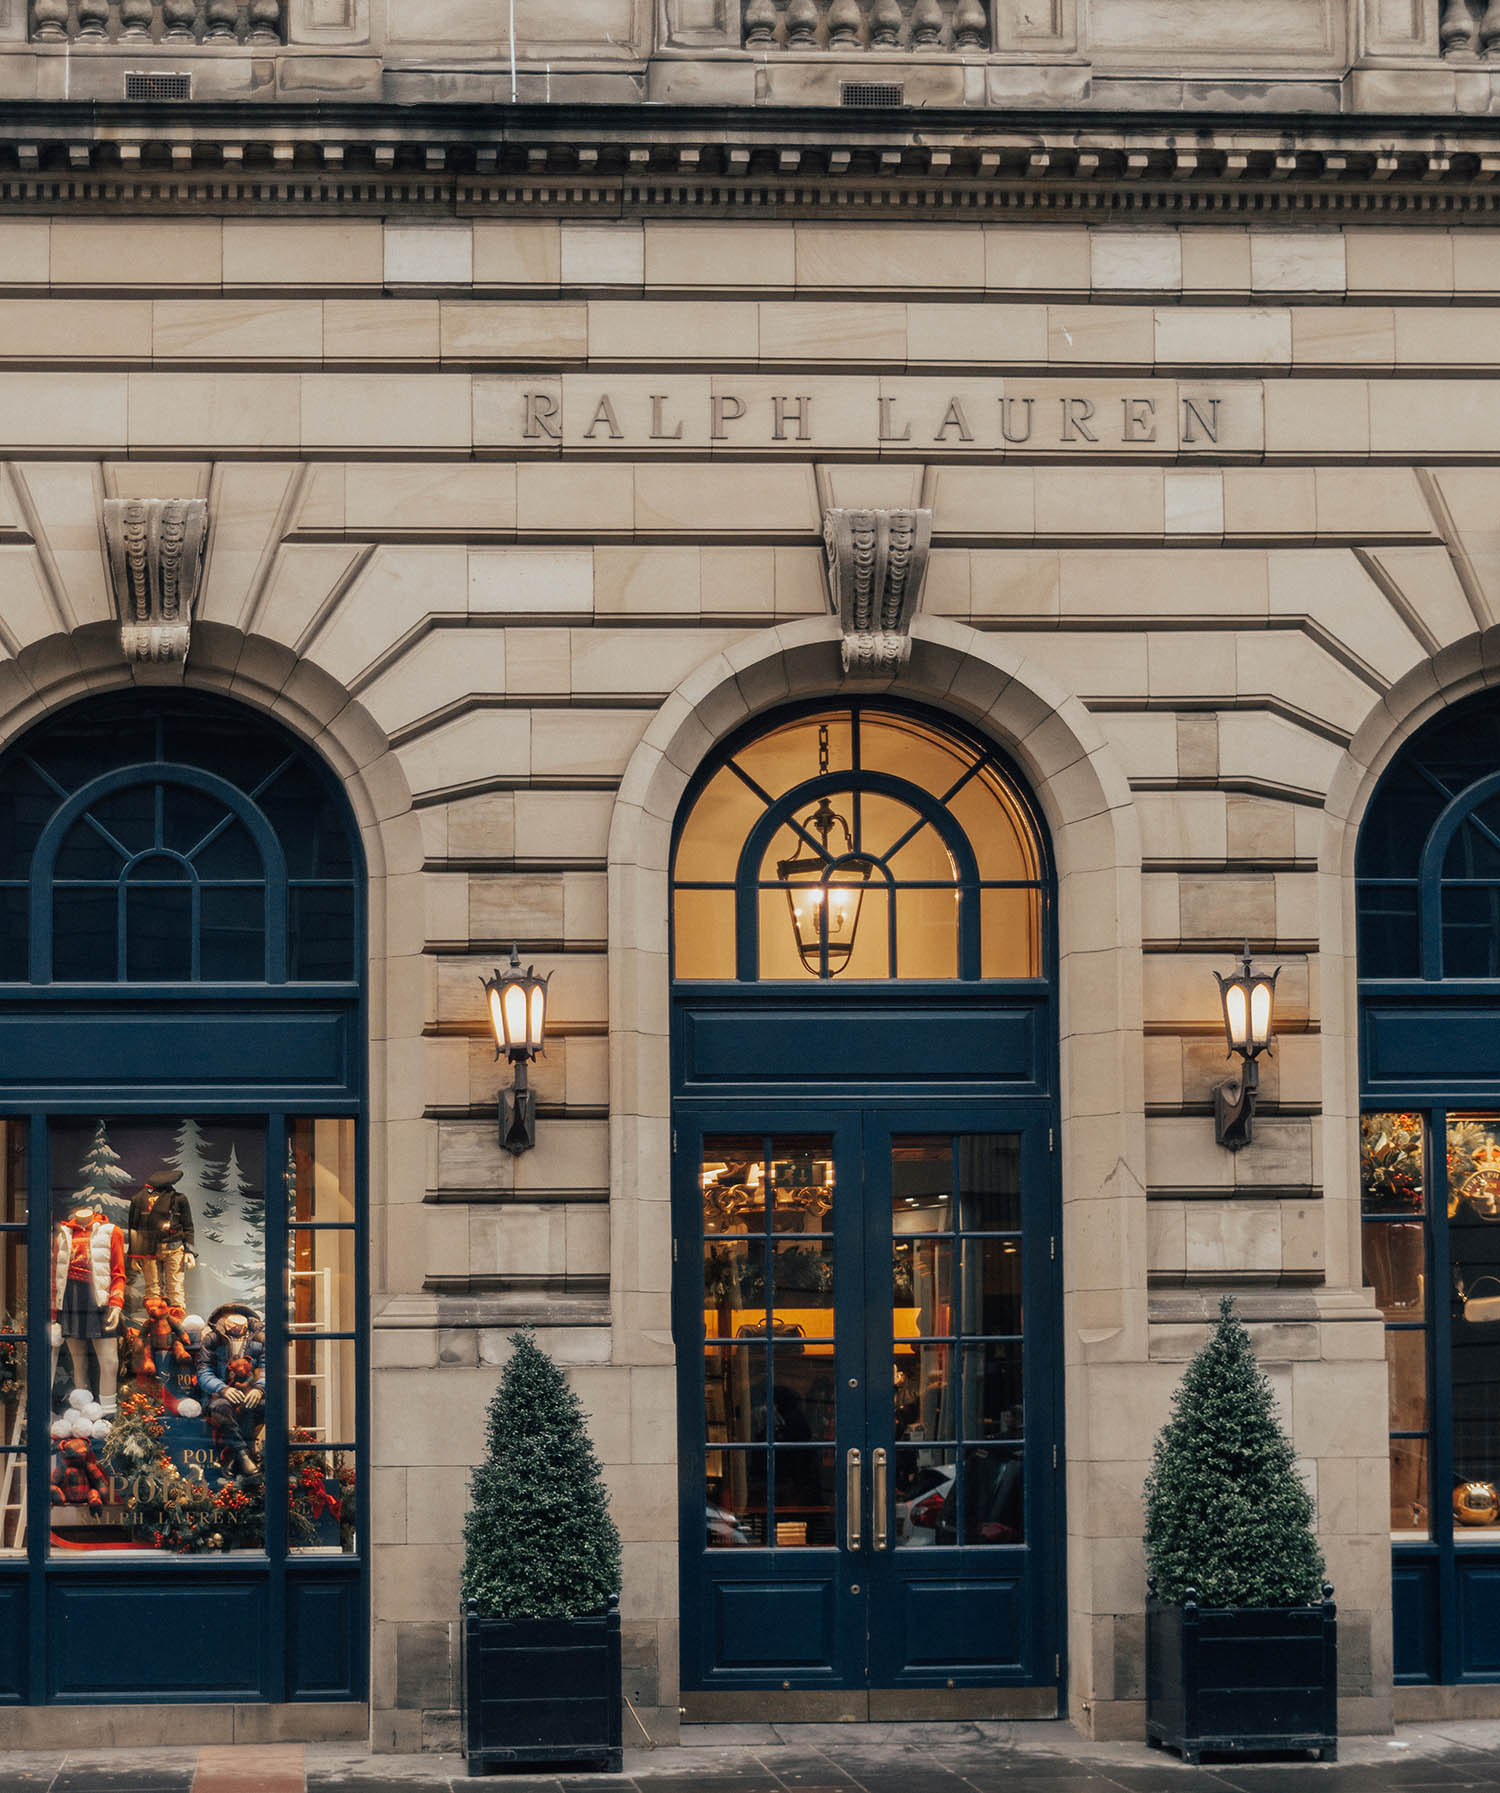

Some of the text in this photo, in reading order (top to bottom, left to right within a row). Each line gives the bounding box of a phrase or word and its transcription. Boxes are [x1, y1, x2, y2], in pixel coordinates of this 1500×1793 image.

[522, 393, 1222, 444] RALPH LAUREN
[109, 1475, 210, 1505] POLO
[80, 1511, 239, 1526] RALPH LAUREN
